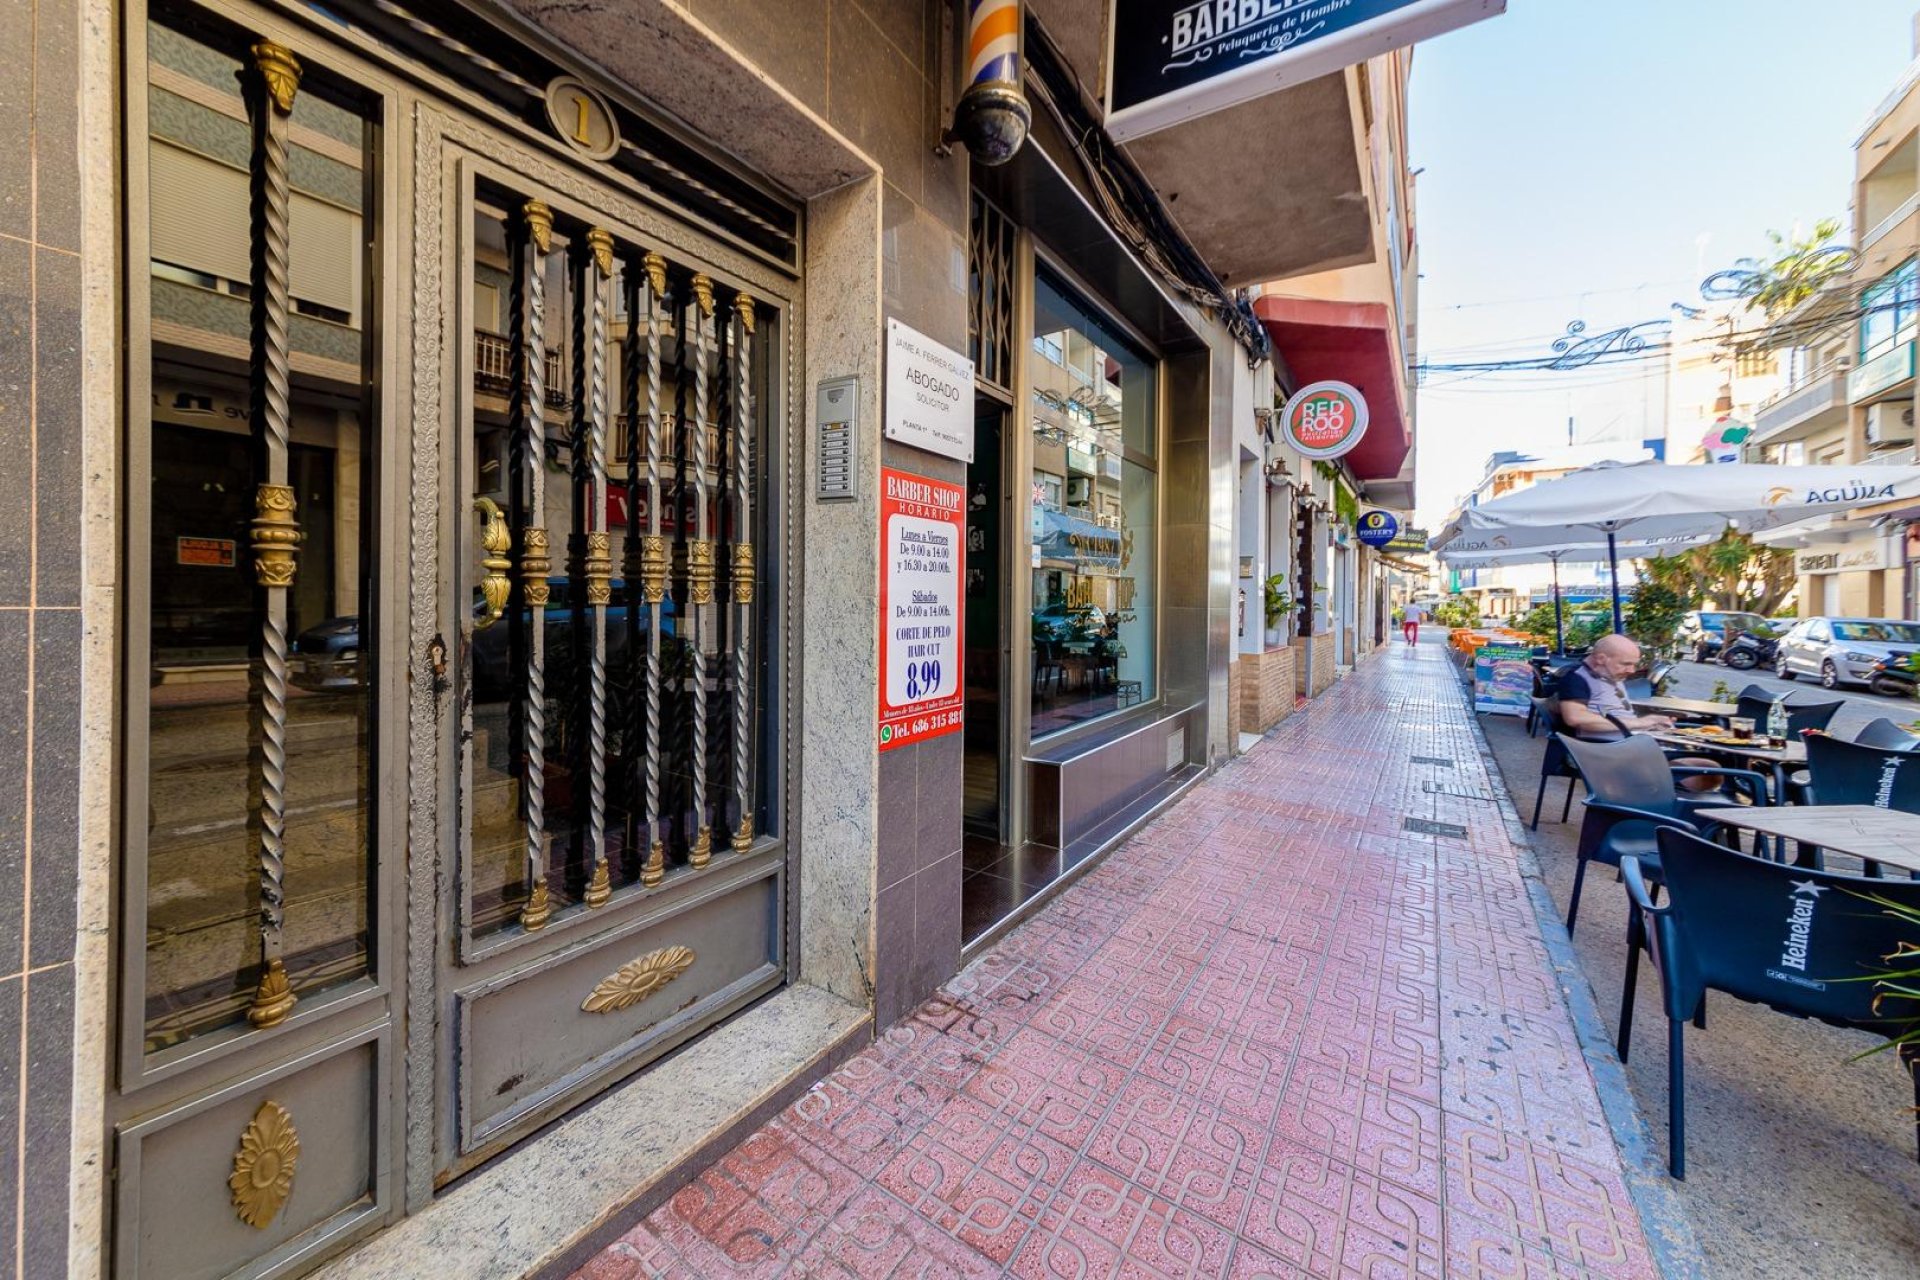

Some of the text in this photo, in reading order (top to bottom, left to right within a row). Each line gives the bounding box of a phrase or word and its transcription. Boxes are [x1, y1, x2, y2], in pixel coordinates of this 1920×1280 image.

[1172, 0, 1306, 51] BARB
[1282, 17, 1297, 30] de
[571, 95, 592, 149] 1
[906, 367, 960, 402] ABOGADO
[916, 391, 950, 412] SOLICITOR
[1302, 400, 1345, 419] RED
[1301, 415, 1345, 433] ROO
[887, 476, 961, 509] BARBER SHOP
[899, 502, 950, 520] HORARIO
[901, 526, 920, 542] Lunes
[927, 530, 948, 545] Viernes
[900, 542, 910, 555] De
[910, 544, 925, 557] 9.00
[932, 546, 949, 559] 14.00
[897, 561, 902, 573] y
[904, 559, 922, 571] 16.30
[896, 605, 906, 618] De
[907, 605, 922, 618] 9.00
[896, 625, 951, 641] CORTE DE PELO
[908, 643, 941, 658] HAIR CUT
[907, 659, 941, 700] 8,99
[892, 709, 963, 739] Tel. 686 315 881
[1875, 767, 1897, 809] Heineken
[1782, 898, 1815, 971] Heineken
